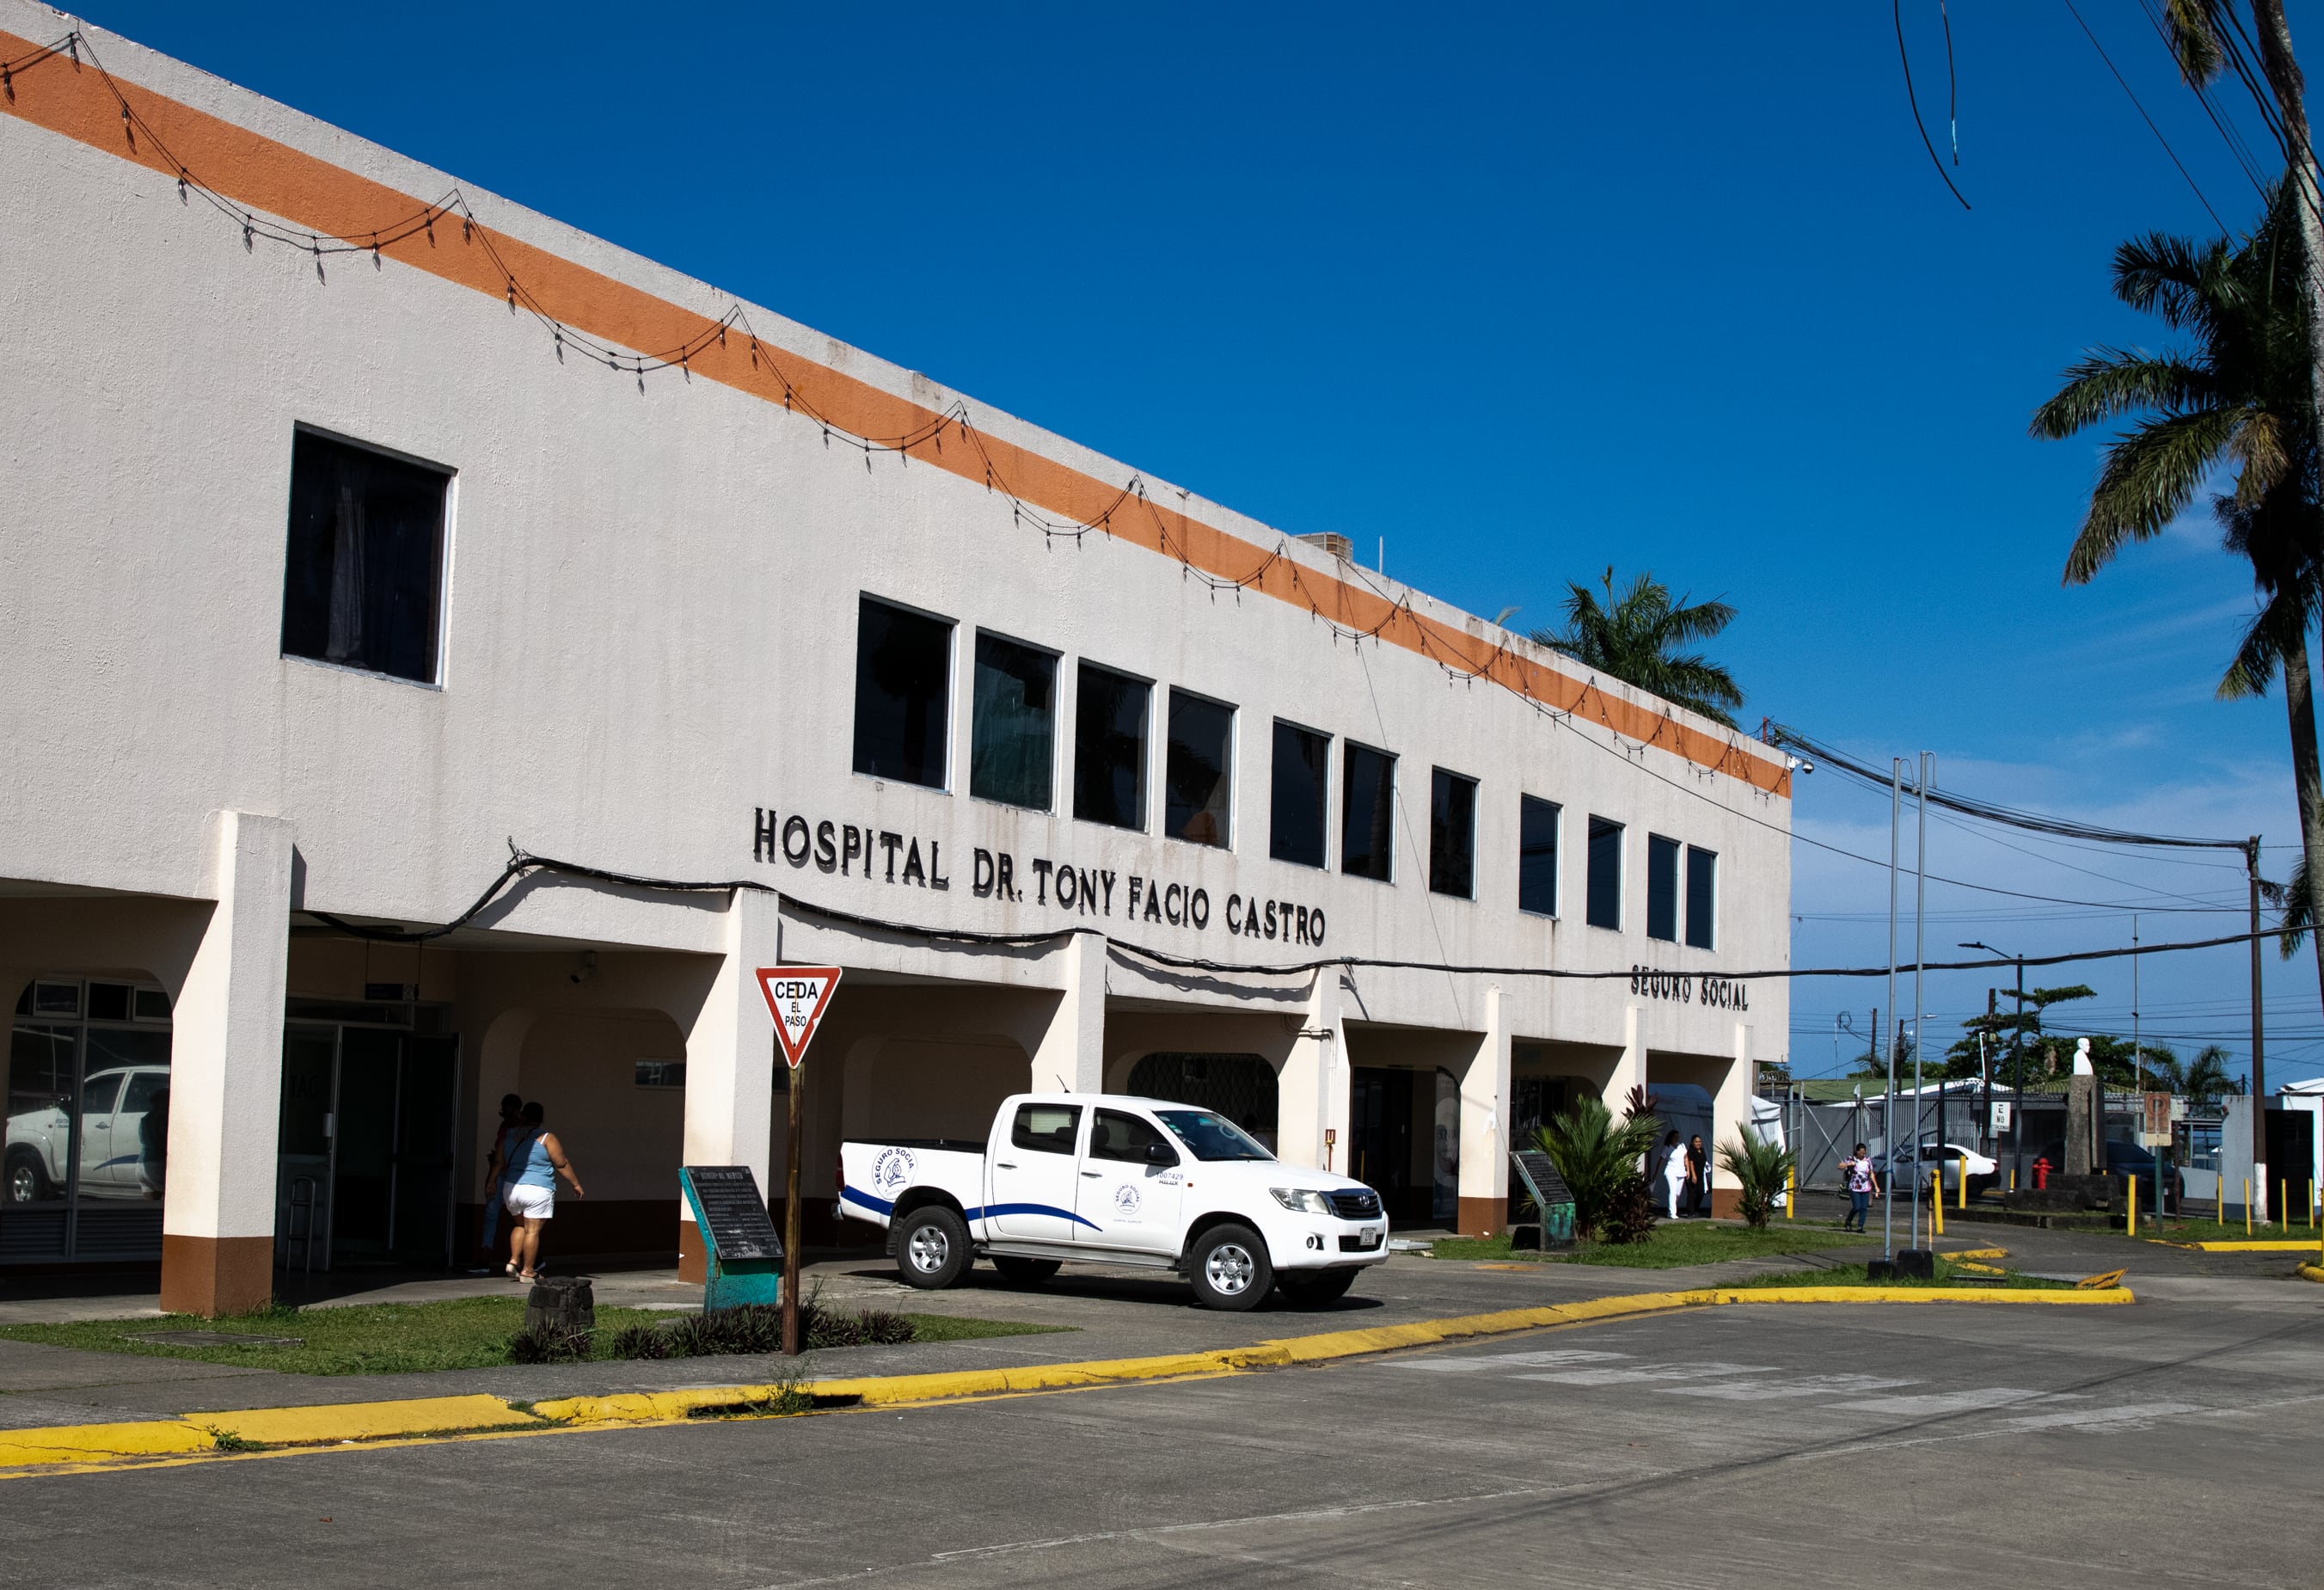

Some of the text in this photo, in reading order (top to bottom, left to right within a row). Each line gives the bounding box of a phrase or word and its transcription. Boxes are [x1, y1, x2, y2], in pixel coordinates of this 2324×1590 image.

[754, 807, 1325, 944] HOSPITAL DR. TONY FACIO CASTRO
[775, 981, 819, 999] CEDA
[1630, 964, 1748, 1010] SEGURO SOCIAL
[791, 1002, 801, 1013] EL
[785, 1016, 806, 1027] PASO
[1996, 1115, 2005, 1124] NO
[875, 1148, 914, 1184] SEGURO SOCIA
